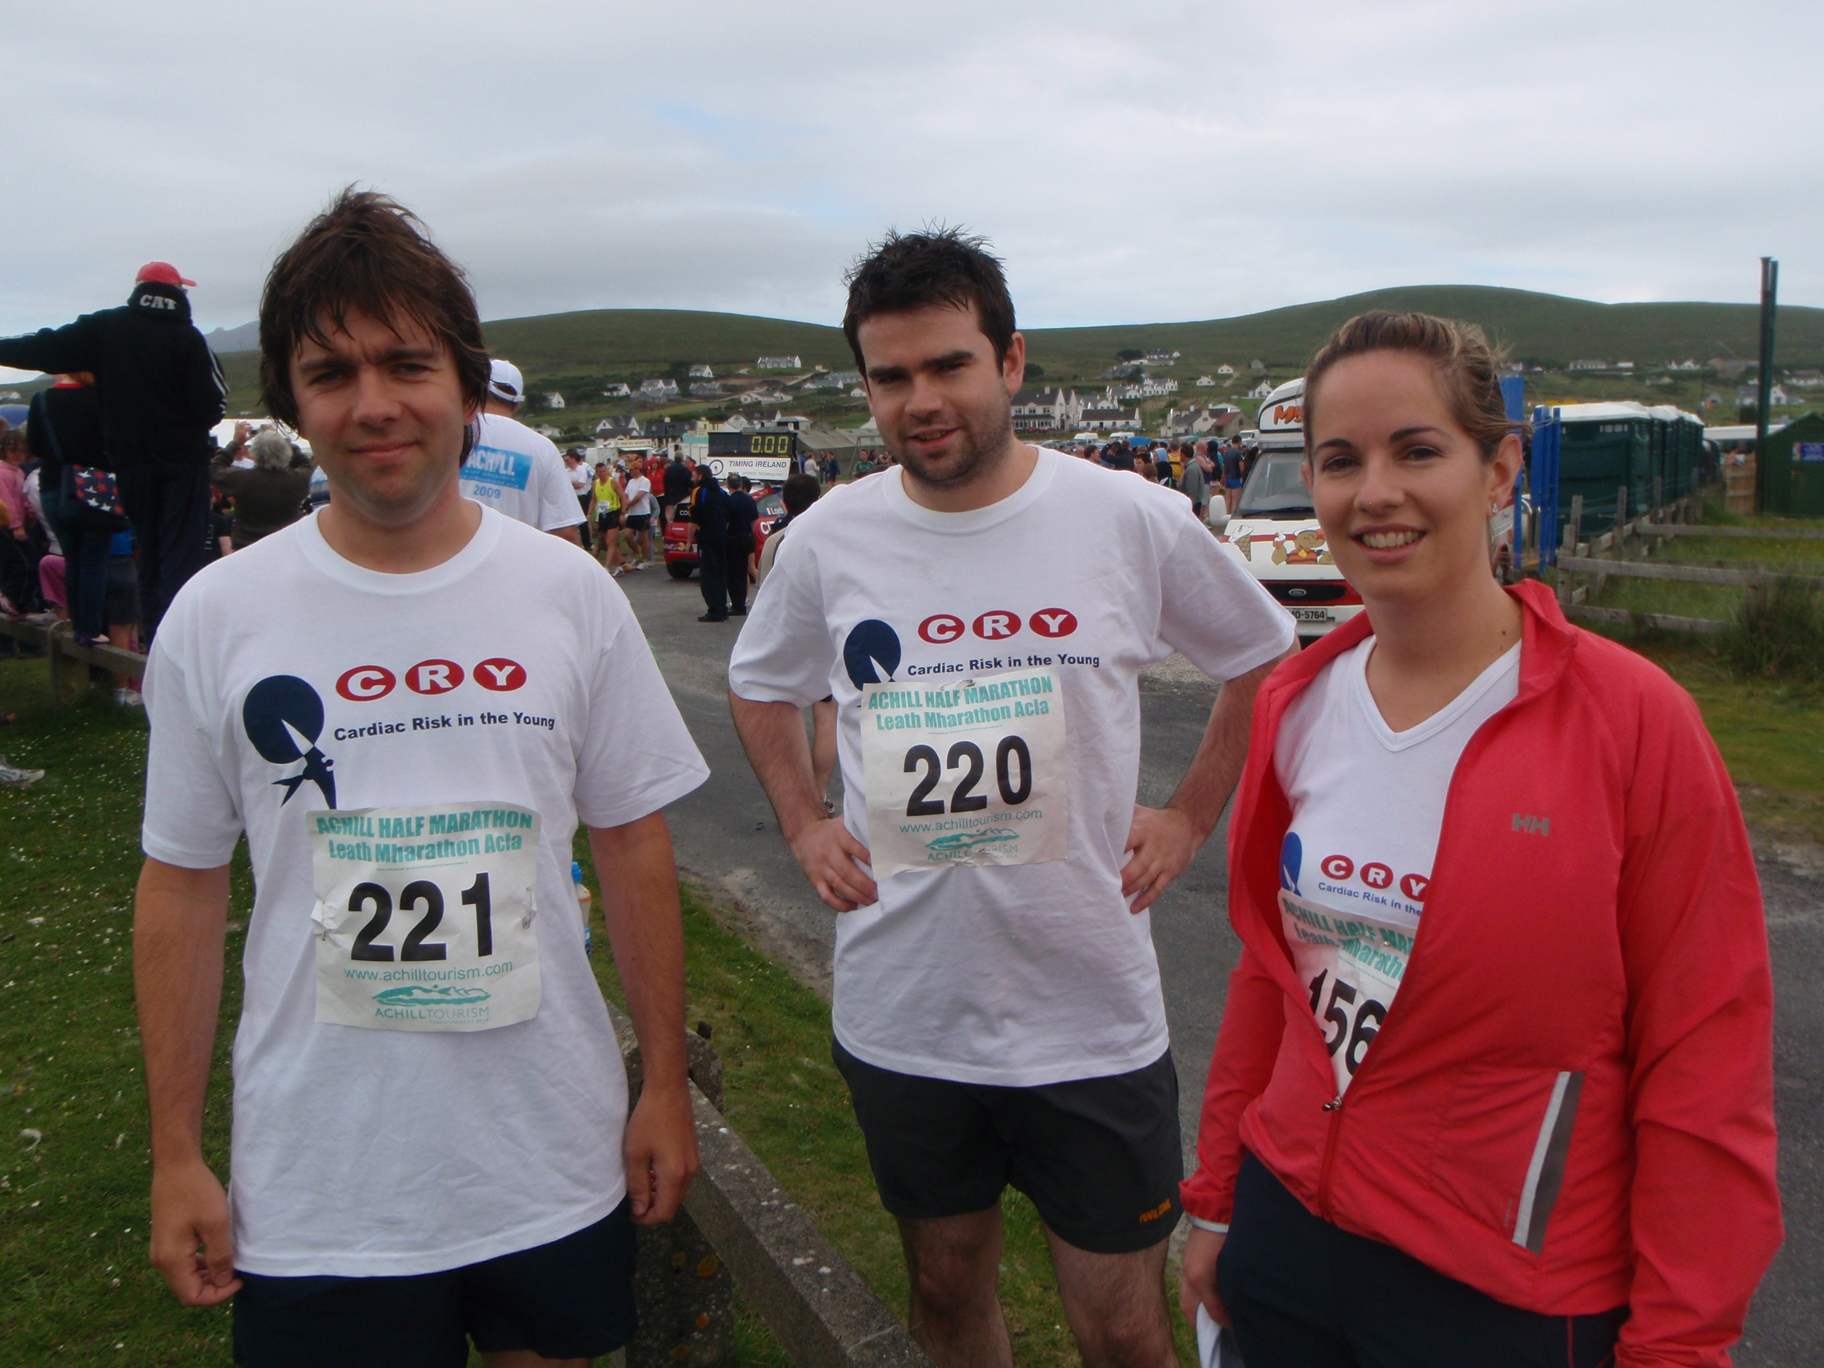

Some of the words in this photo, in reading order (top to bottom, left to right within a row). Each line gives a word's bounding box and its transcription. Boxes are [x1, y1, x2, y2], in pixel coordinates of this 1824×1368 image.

[139, 294, 178, 310] CAT
[729, 460, 754, 468] TIMING
[755, 461, 787, 469] IRELAND
[473, 484, 501, 499] 2009
[926, 613, 1069, 642] CRY
[907, 662, 964, 676] Cardiac
[969, 657, 1003, 671] Risk
[1008, 656, 1022, 668] in
[1027, 655, 1053, 667] the
[1057, 653, 1100, 668] Young
[346, 664, 517, 698] CRY
[868, 691, 923, 710] ACHILL
[924, 689, 961, 709] HALF
[964, 675, 1053, 705] MARATHON
[334, 721, 406, 741] Cardiac
[411, 715, 453, 732] Risk
[458, 714, 474, 727] in
[480, 712, 508, 725] the
[513, 711, 556, 731] Young
[876, 711, 922, 731] Leath
[924, 703, 1012, 729] Mharathon
[1014, 698, 1050, 718] Acla
[903, 734, 1033, 817] 220
[316, 816, 375, 838] ACHILL
[379, 815, 426, 839] HALF
[429, 808, 533, 836] MARATHON
[899, 809, 1043, 834] www.achilltourism.com
[328, 839, 373, 862] Leath
[375, 837, 481, 864] Mharathon
[484, 831, 523, 855] Acla
[1327, 859, 1427, 897] CRY
[1318, 881, 1360, 899] Cardiac
[1362, 891, 1388, 906] Risk
[1391, 898, 1402, 911] in
[1405, 904, 1422, 918] the
[347, 871, 493, 963] 221
[1282, 897, 1334, 934] ACHILL
[344, 960, 514, 982] www.achilltourism.com
[374, 1005, 491, 1020] ACHILLTOURISM
